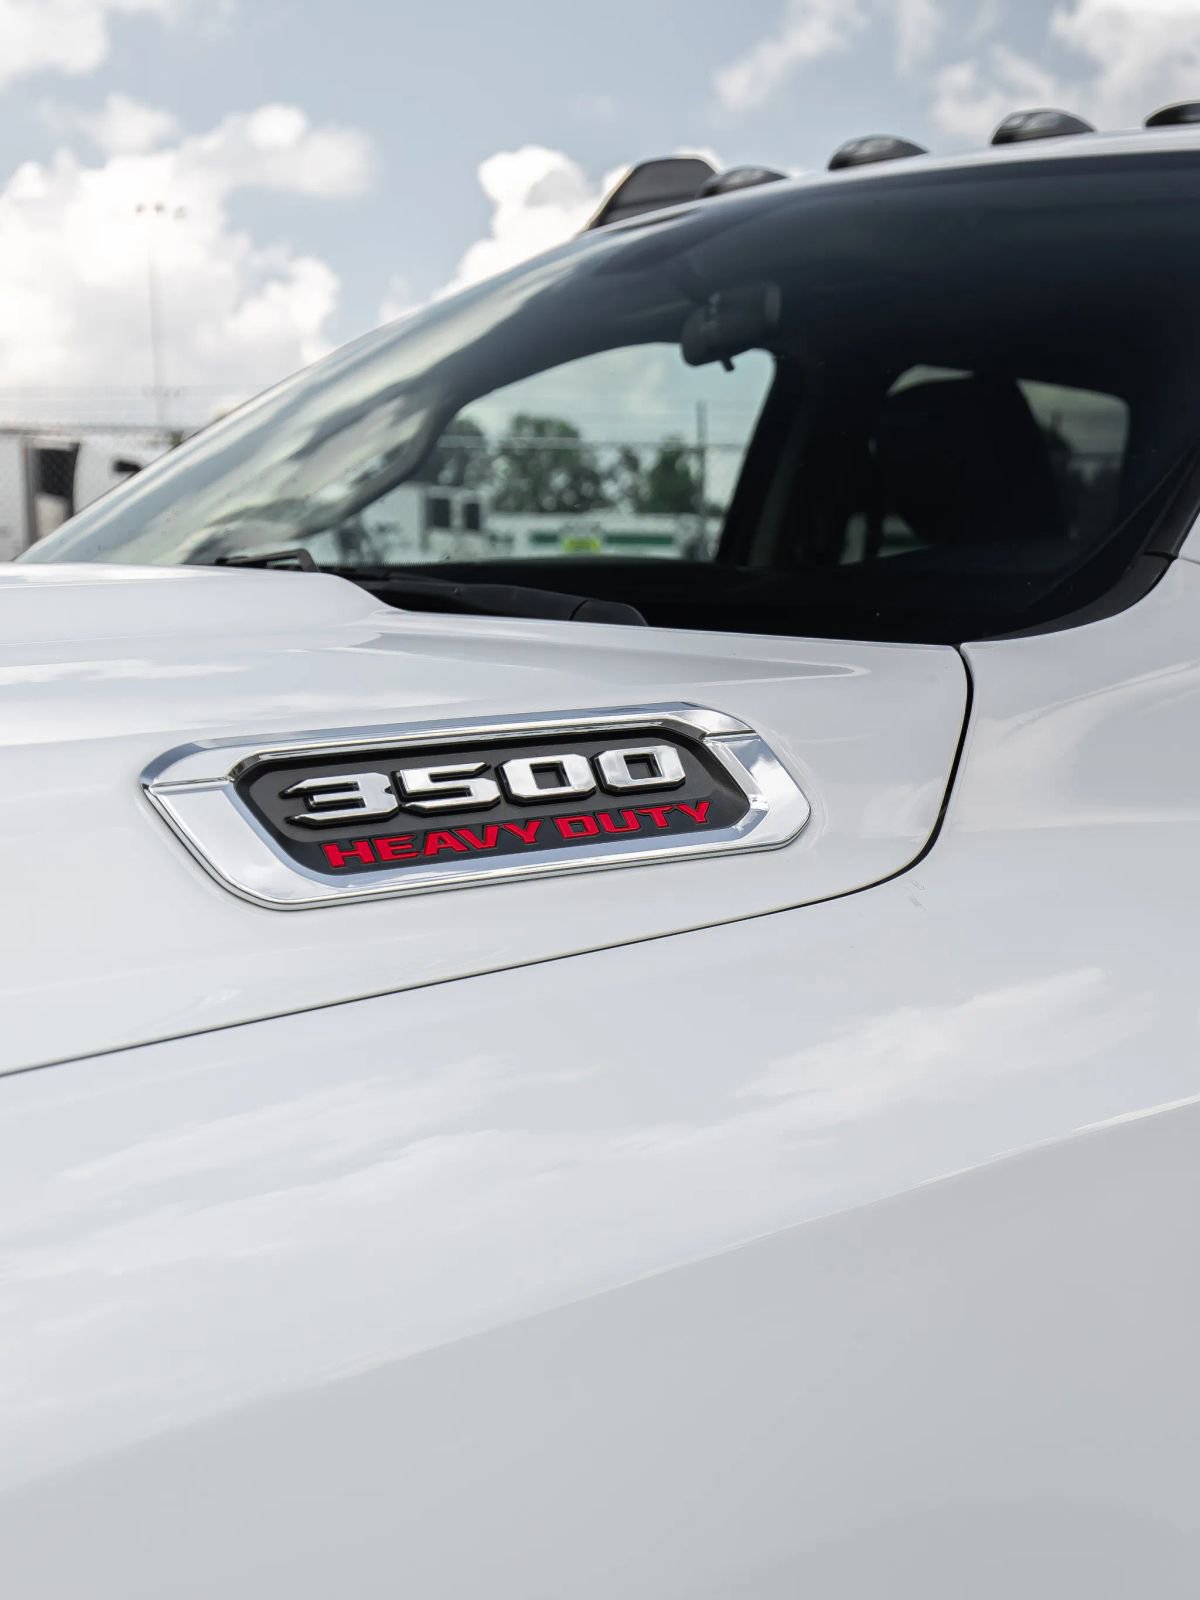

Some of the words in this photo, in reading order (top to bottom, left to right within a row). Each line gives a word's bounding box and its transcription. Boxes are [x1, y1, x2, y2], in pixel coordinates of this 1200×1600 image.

[282, 744, 687, 827] 3500
[321, 820, 544, 869] HEAVY
[556, 801, 713, 840] DUTY
